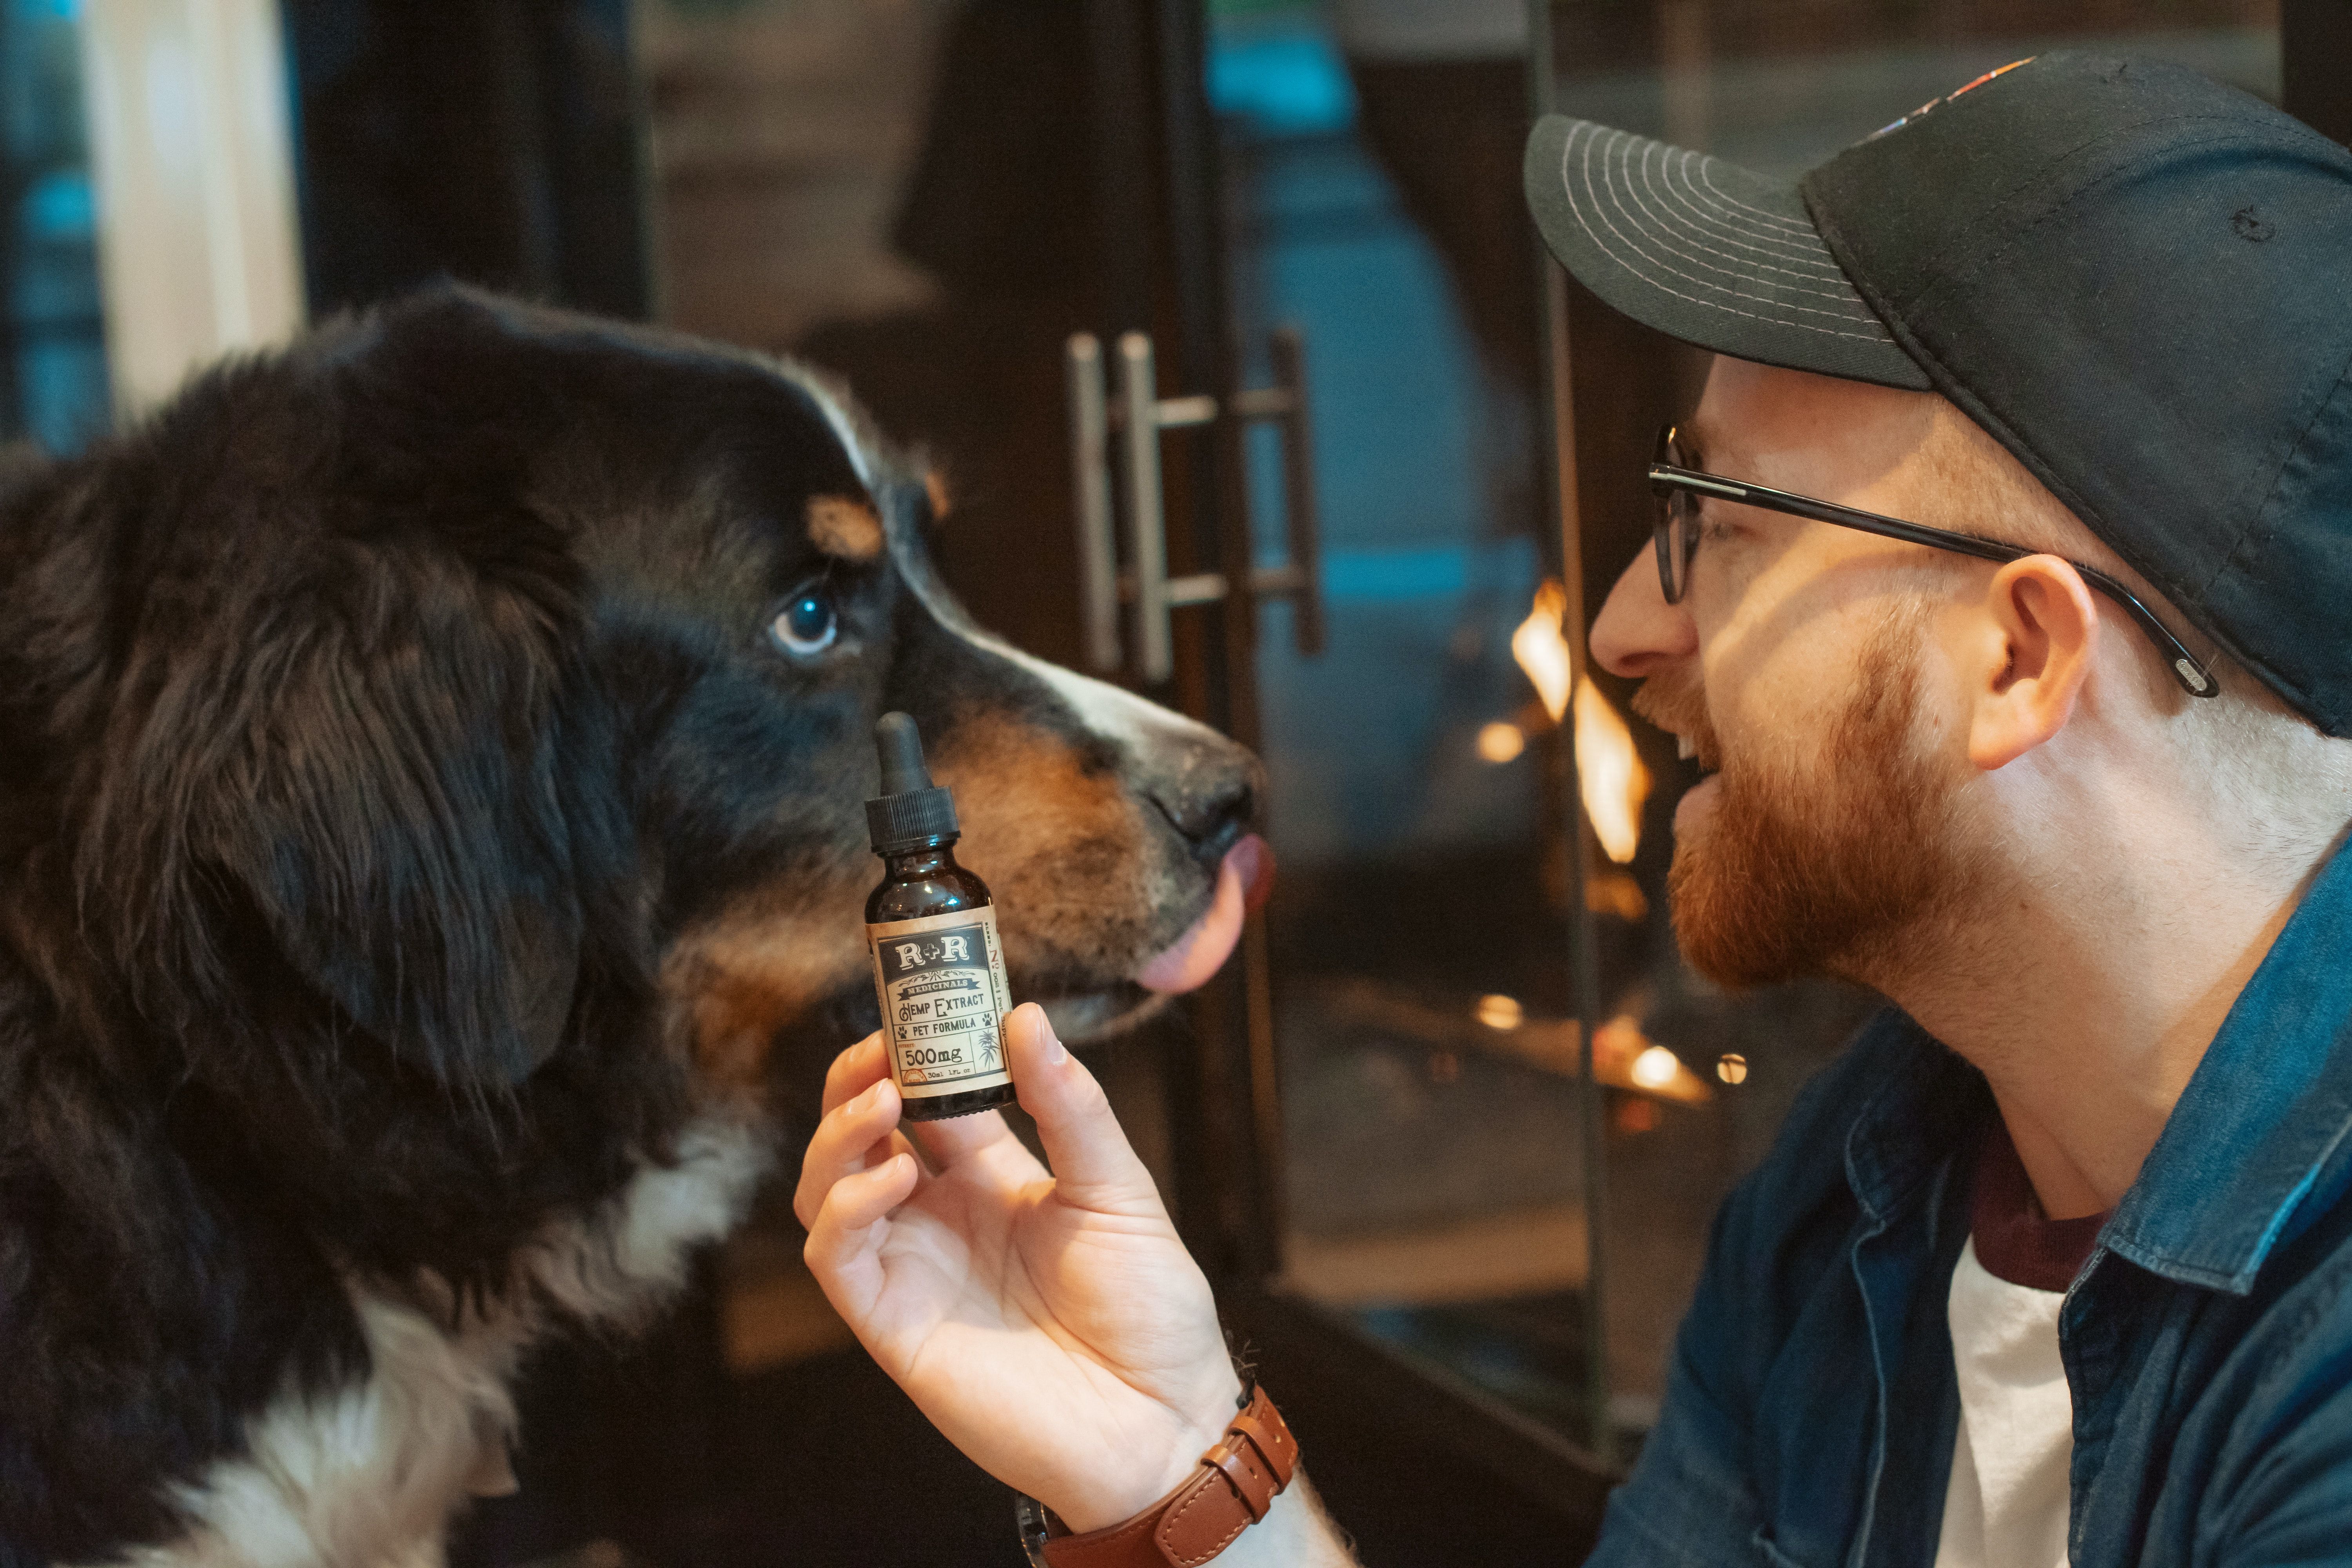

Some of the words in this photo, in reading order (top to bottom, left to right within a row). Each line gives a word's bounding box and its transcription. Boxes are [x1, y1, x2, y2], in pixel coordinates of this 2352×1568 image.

[895, 936, 969, 971] R+R
[908, 980, 968, 995] MEDICINALS
[913, 1025, 929, 1036] PET
[933, 1018, 976, 1034] FORMULA
[906, 1048, 962, 1066] 500mg
